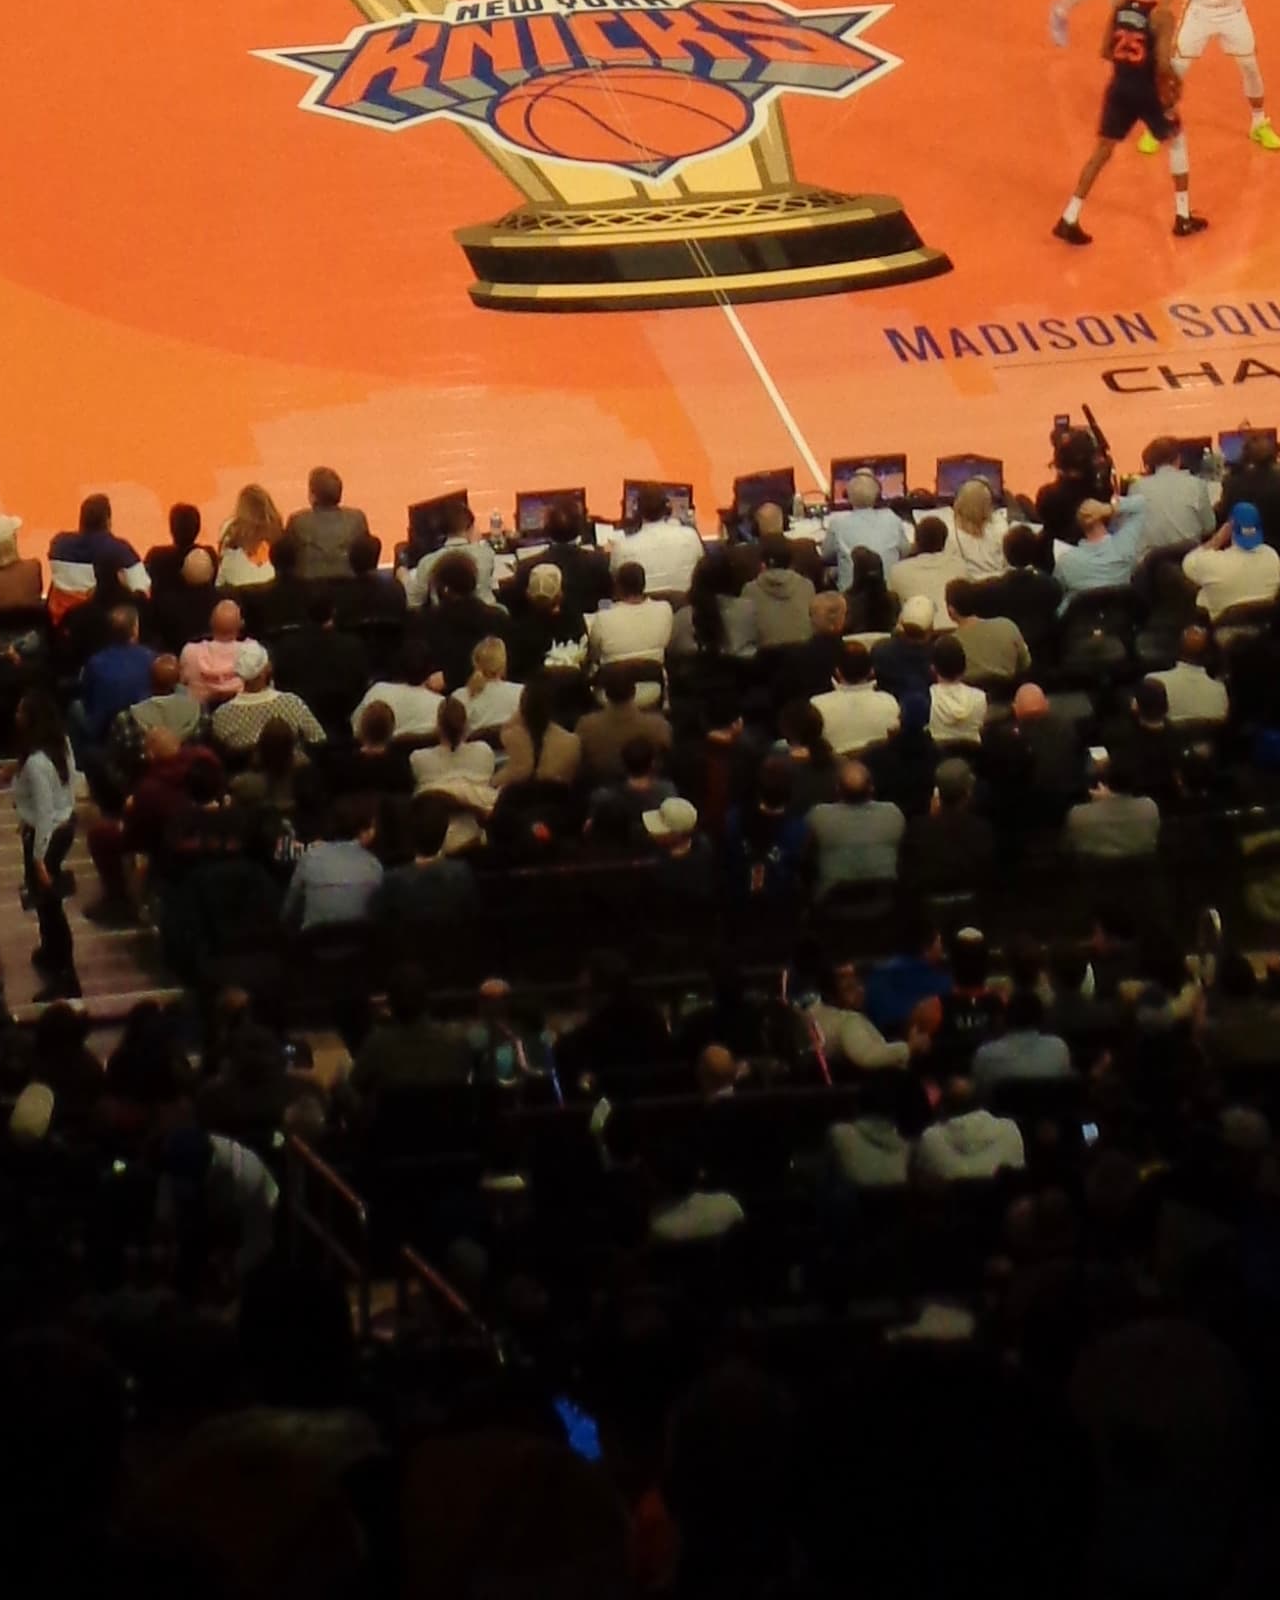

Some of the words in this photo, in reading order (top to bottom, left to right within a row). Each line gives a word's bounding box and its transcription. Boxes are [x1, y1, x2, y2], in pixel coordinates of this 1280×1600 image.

[320, 0, 885, 112] KNICKS
[1113, 29, 1146, 63] 25
[882, 311, 1159, 364] MADISON
